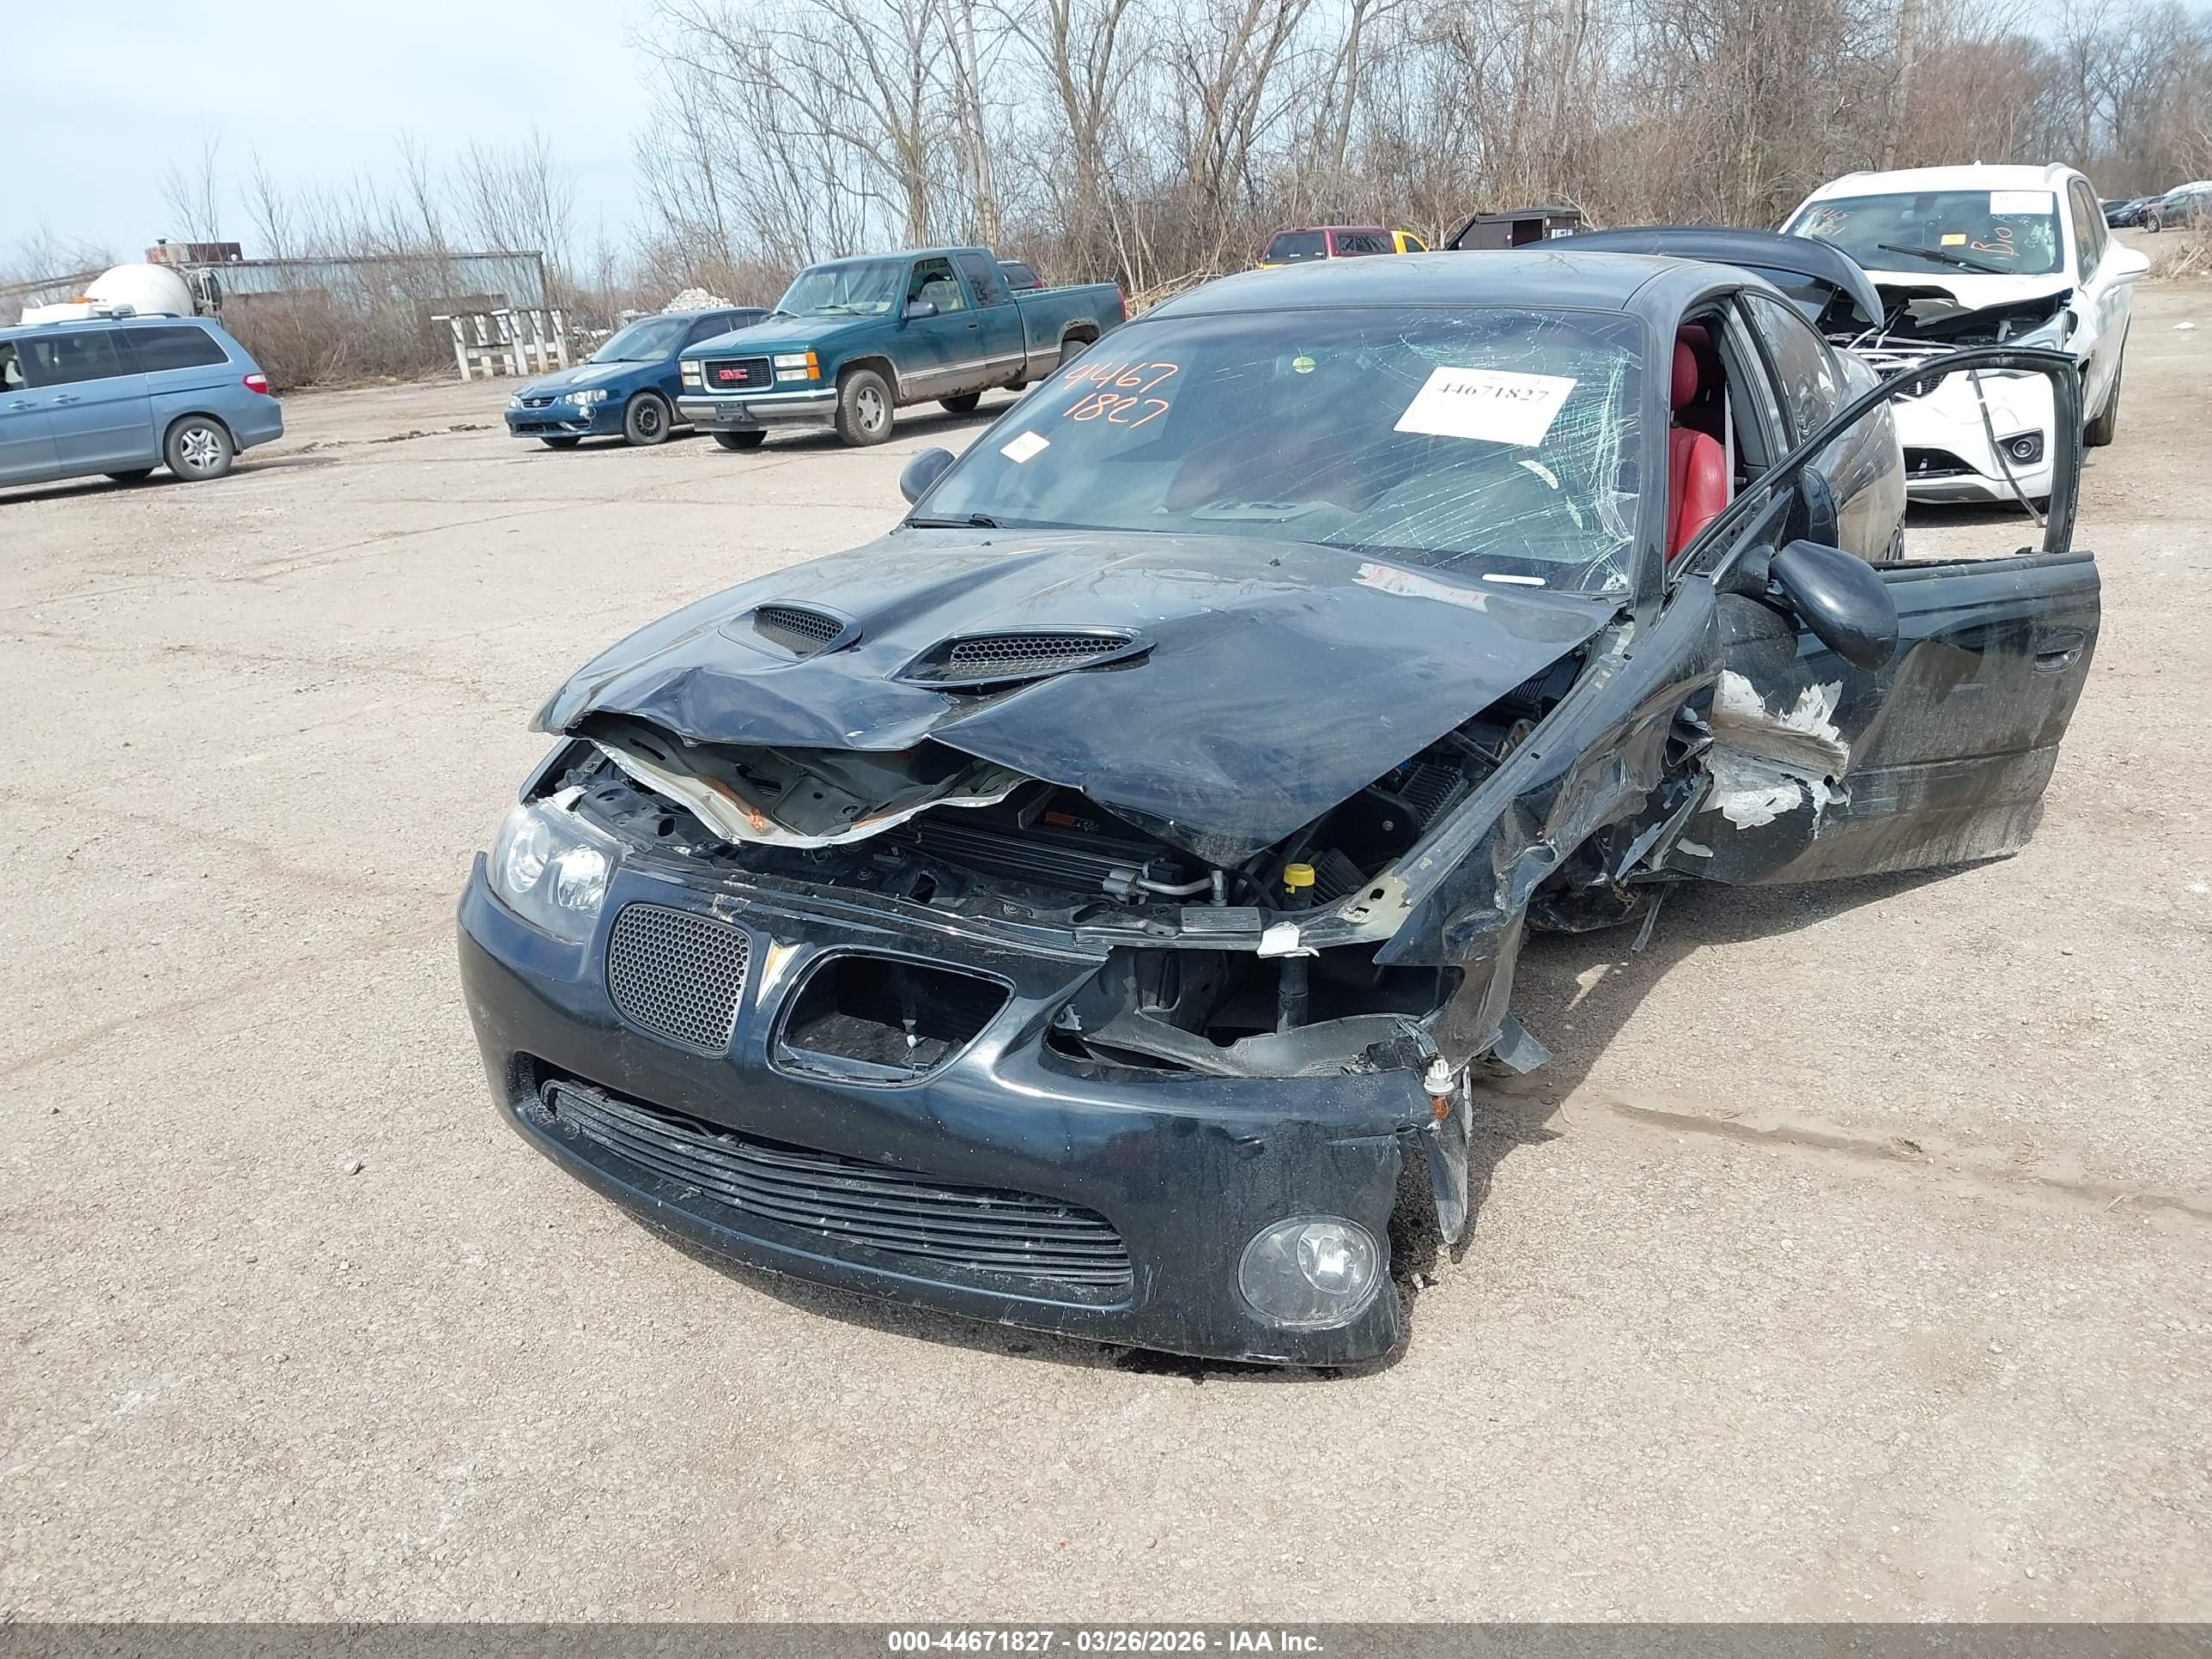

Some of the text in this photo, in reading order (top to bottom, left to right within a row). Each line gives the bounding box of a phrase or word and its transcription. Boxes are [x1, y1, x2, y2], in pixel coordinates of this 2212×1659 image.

[718, 368, 749, 380] GMC
[1063, 362, 1179, 393] 4467
[1437, 381, 1550, 402] 44671827
[1062, 392, 1170, 428] 1827
